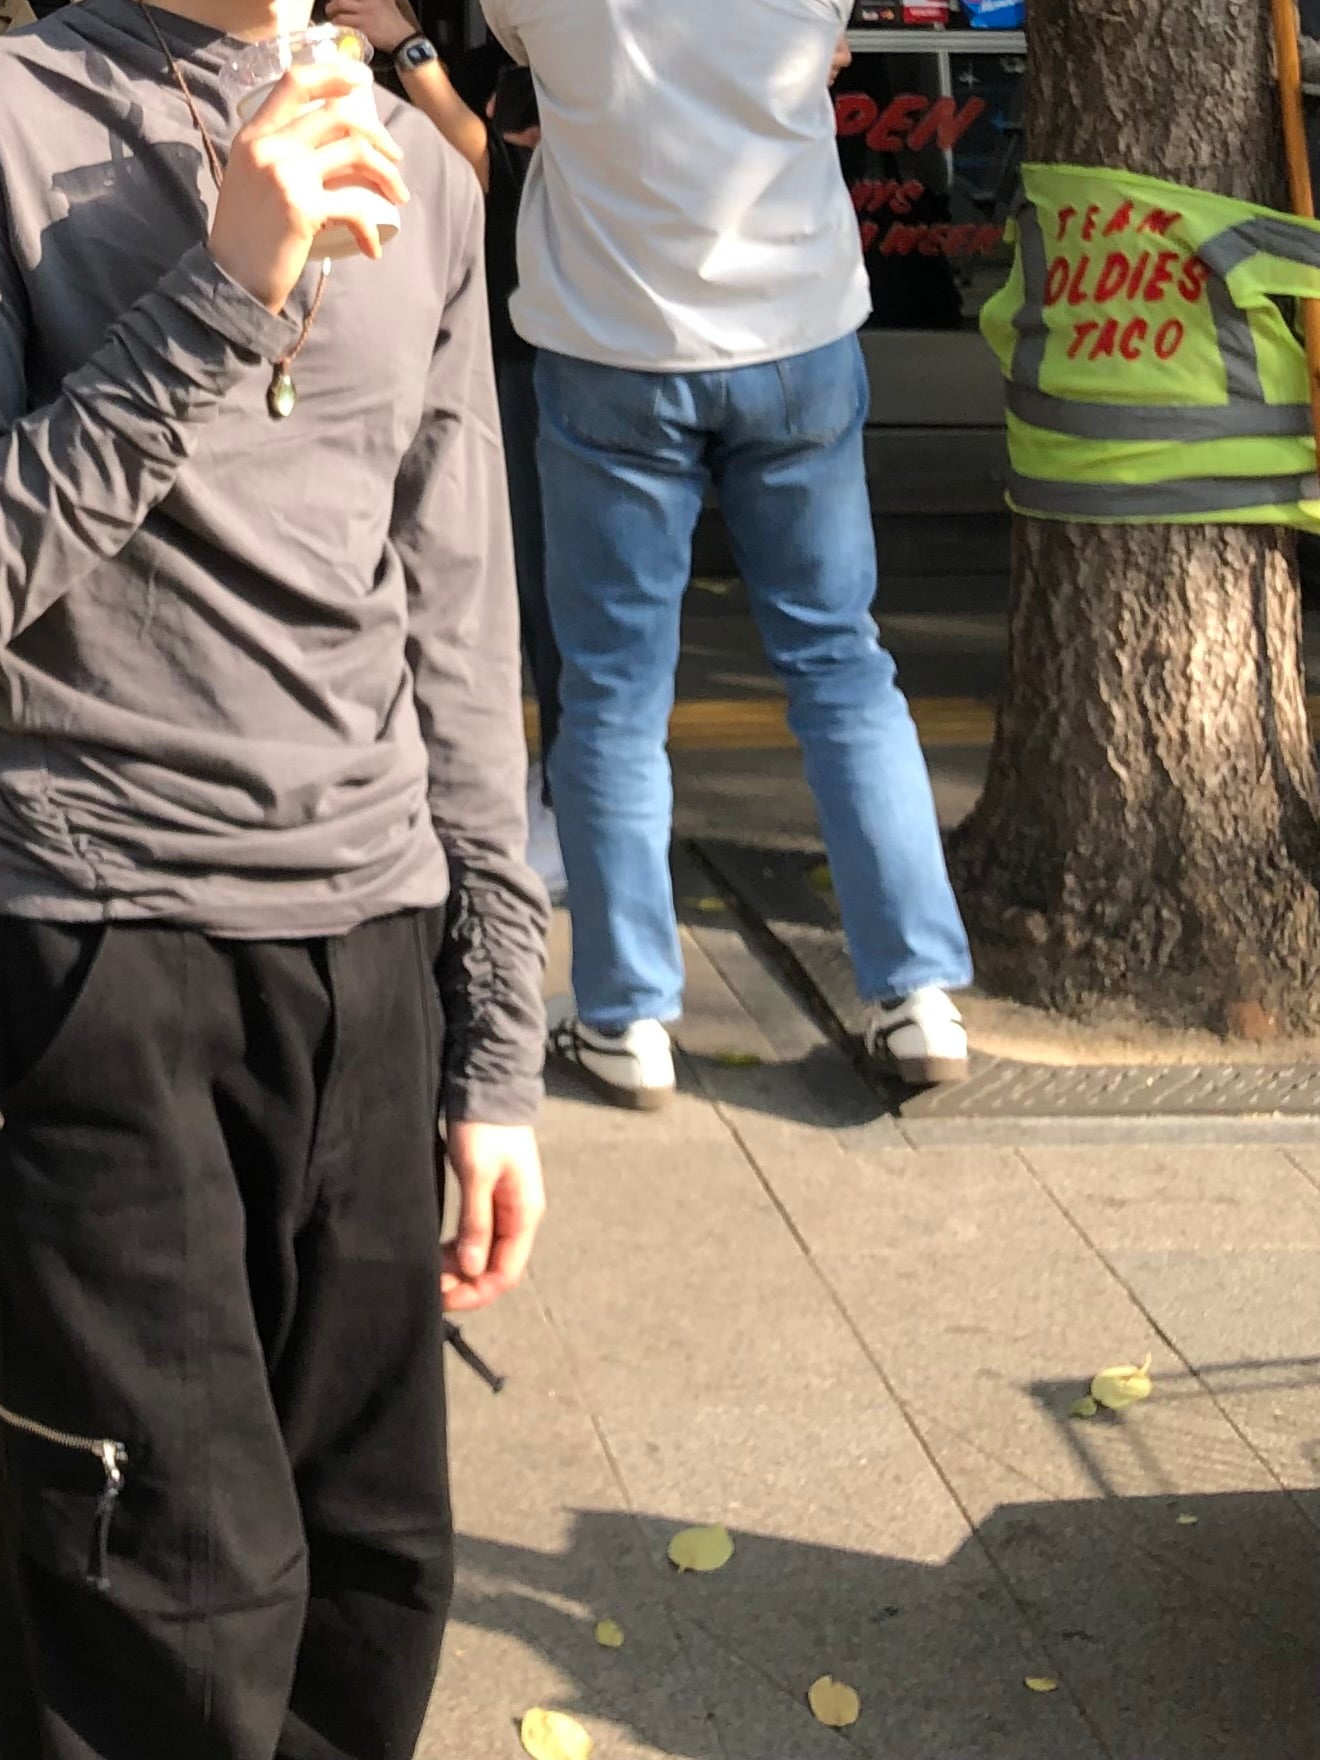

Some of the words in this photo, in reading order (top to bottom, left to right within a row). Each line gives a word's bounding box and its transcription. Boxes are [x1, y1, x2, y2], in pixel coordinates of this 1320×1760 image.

[1057, 200, 1183, 242] TEAM
[1043, 249, 1212, 308] OLDIES
[1066, 317, 1185, 362] TACO
